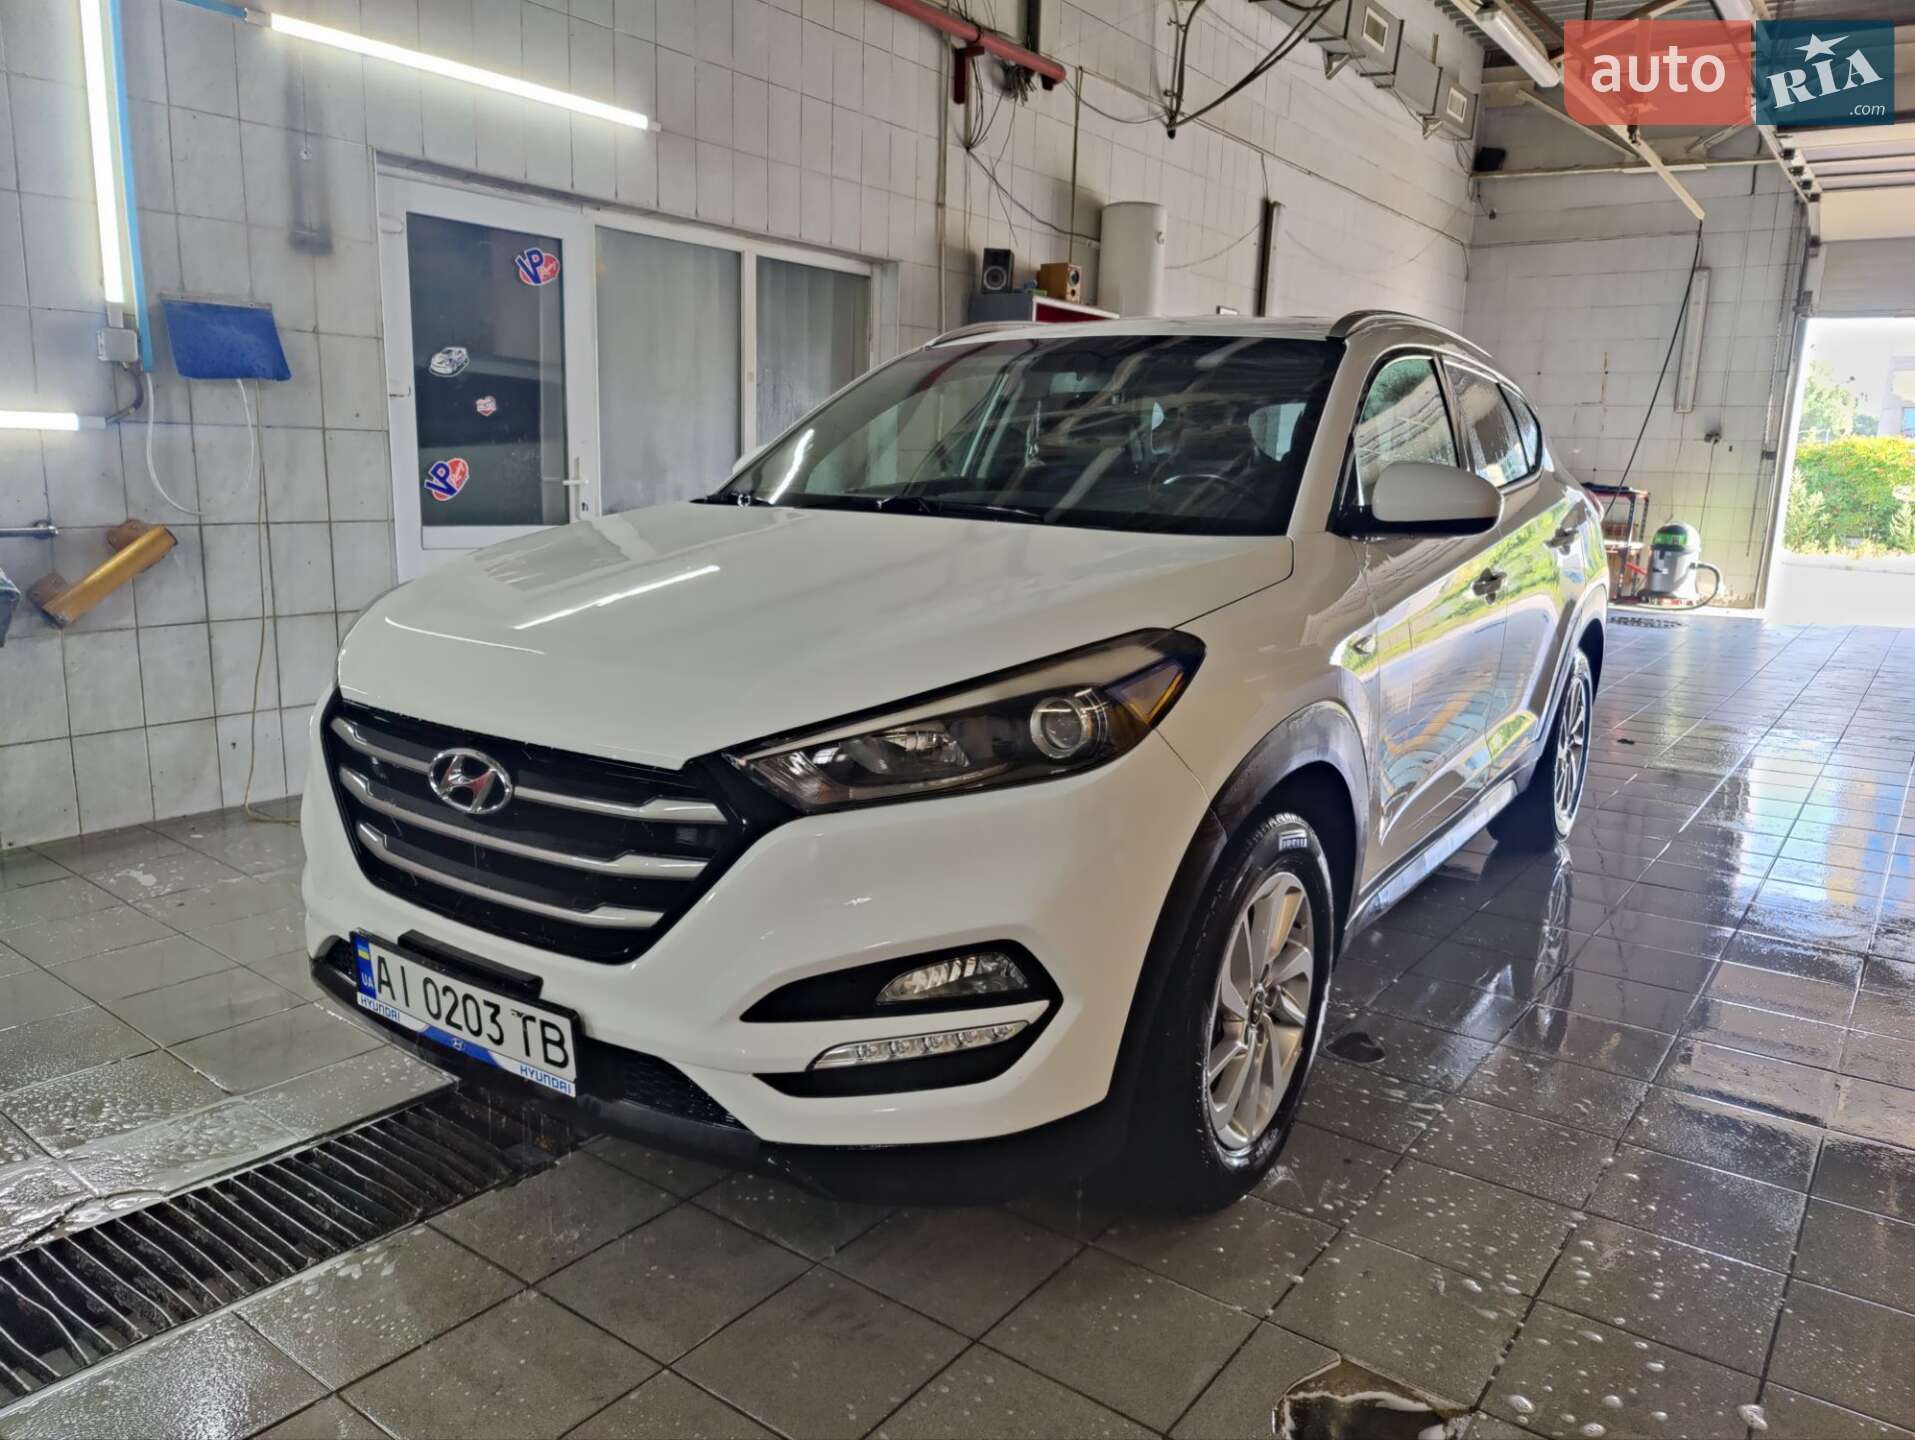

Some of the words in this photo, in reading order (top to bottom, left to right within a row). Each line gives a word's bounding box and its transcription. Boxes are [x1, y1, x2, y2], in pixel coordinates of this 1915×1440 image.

[515, 249, 544, 284] VP
[425, 462, 457, 497] VP
[361, 971, 375, 990] UA
[360, 996, 401, 1021] HYUNDAI
[377, 955, 410, 1008] AI
[423, 977, 504, 1046] 0203
[511, 1008, 569, 1069] TB
[519, 1064, 572, 1094] HYUNDAI
